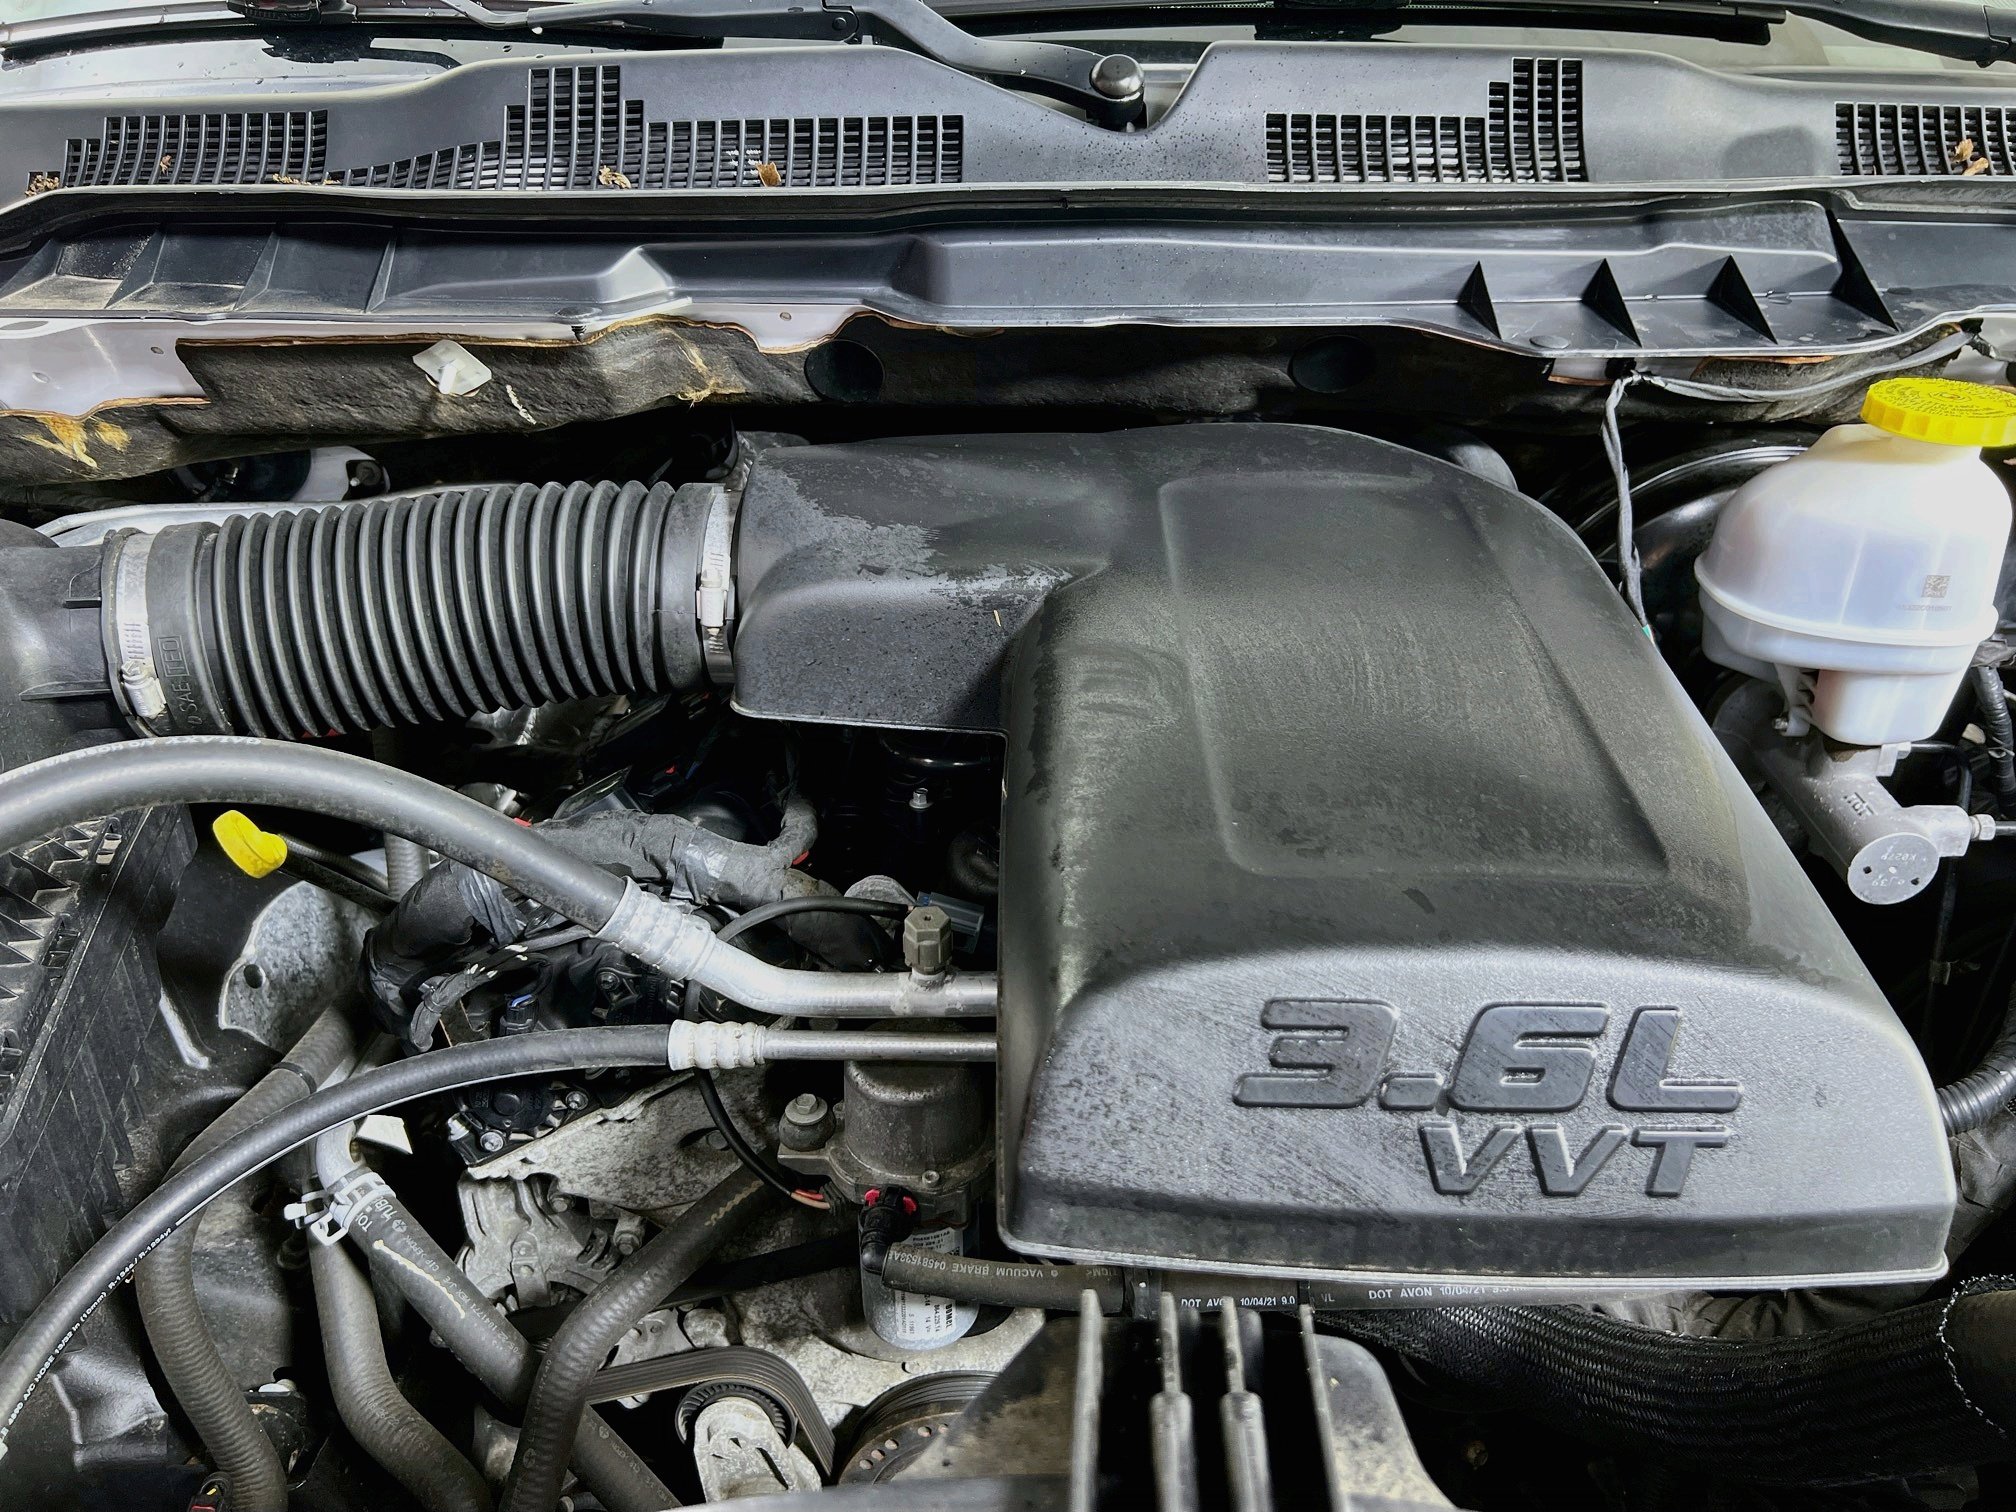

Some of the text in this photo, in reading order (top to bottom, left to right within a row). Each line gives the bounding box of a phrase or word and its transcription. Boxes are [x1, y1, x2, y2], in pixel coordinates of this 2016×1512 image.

[1232, 996, 1743, 1113] 3.6L
[1418, 1119, 1732, 1198] VVT
[951, 1261, 989, 1275] BRAKE
[995, 1266, 1043, 1277] VACUUM
[1368, 1288, 1392, 1299] DOT
[1399, 1286, 1432, 1297] AVON
[1181, 1298, 1201, 1308] DOT
[1239, 1296, 1276, 1306] 10/04/21
[1281, 1295, 1295, 1304] 9.0
[23, 1382, 36, 1400] A/C
[35, 1355, 55, 1382] HOSE
[54, 1331, 74, 1354] 13/32
[80, 1291, 107, 1322] (10mm)
[138, 1227, 172, 1259] R-1234yf
